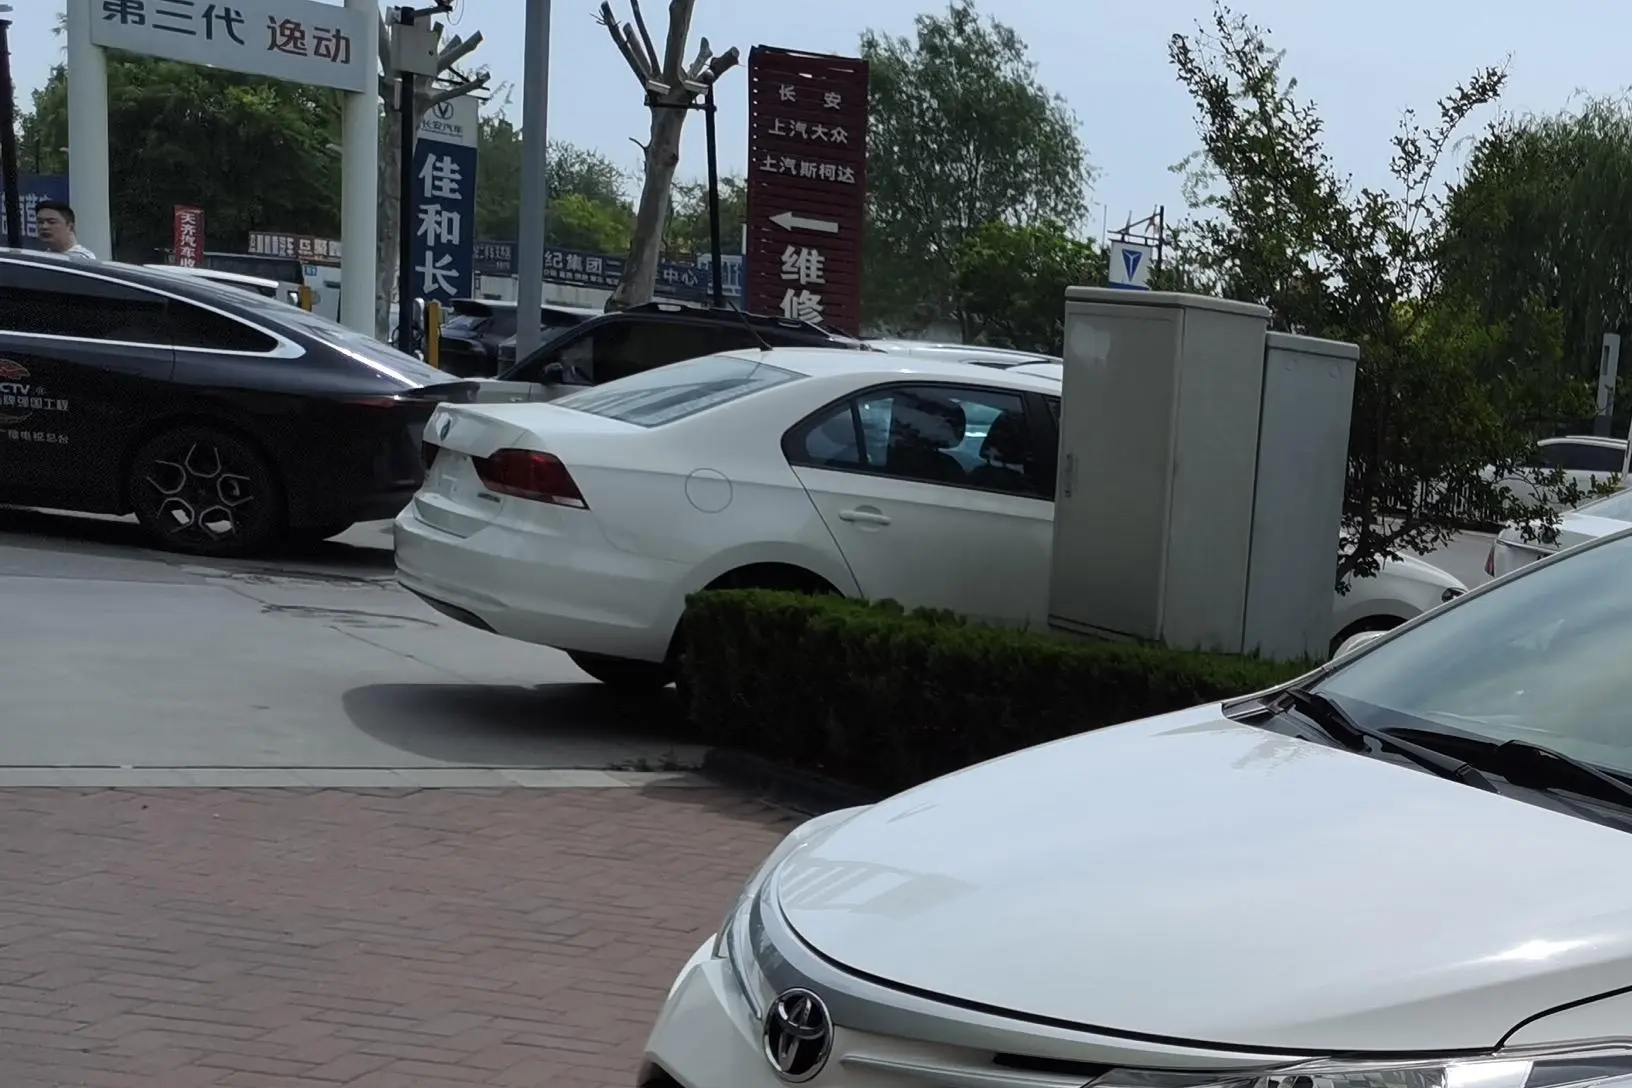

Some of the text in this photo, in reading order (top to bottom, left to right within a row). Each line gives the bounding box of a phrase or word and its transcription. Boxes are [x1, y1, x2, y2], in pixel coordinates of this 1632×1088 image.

[102, 0, 351, 65] 第三代 逸动
[779, 84, 842, 110] 长安
[768, 118, 848, 144] 上汽大众
[415, 152, 463, 312] 佳和长
[780, 245, 826, 324] 维修
